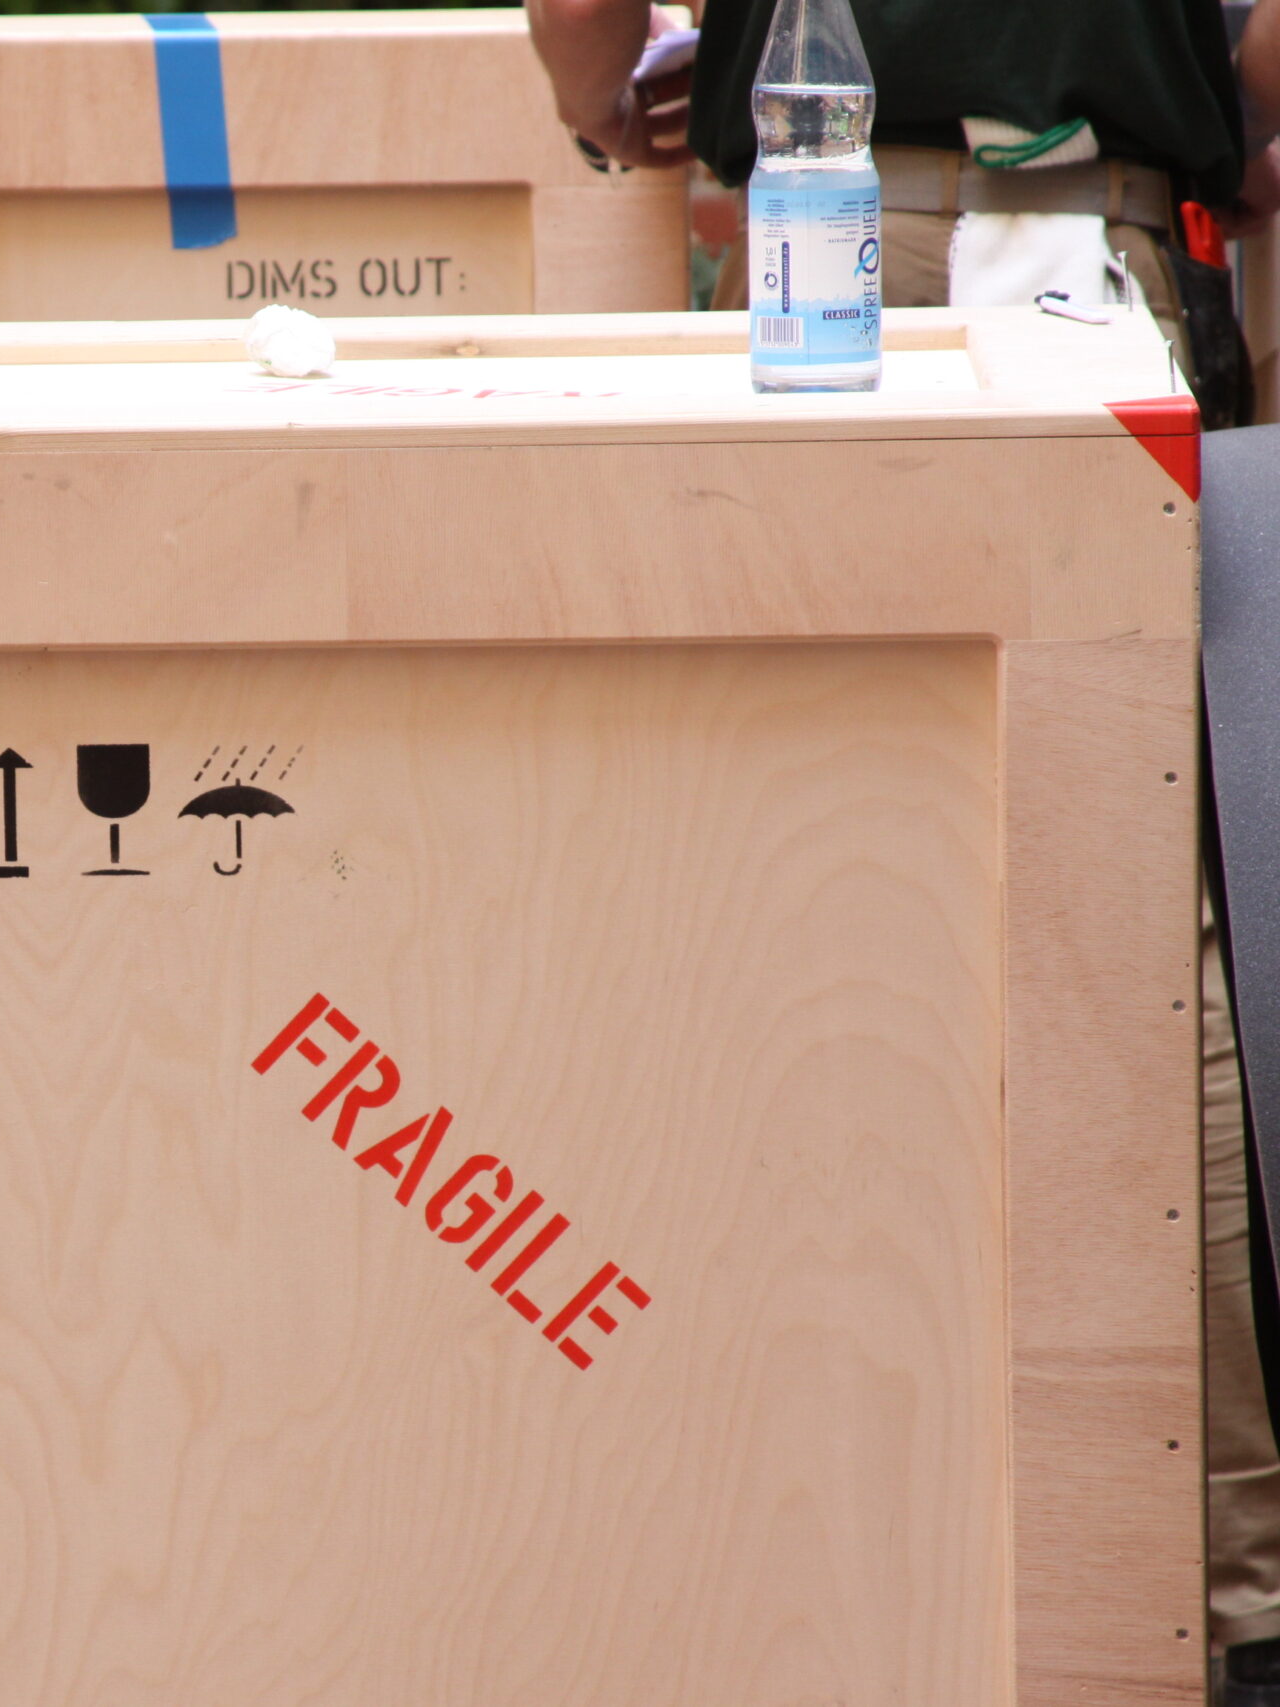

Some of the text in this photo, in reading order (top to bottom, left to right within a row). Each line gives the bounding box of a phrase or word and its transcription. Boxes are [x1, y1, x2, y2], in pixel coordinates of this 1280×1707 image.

[226, 257, 467, 299] DIMS OUT:
[824, 309, 859, 319] CLASSIC
[251, 992, 652, 1371] FRAGILE
